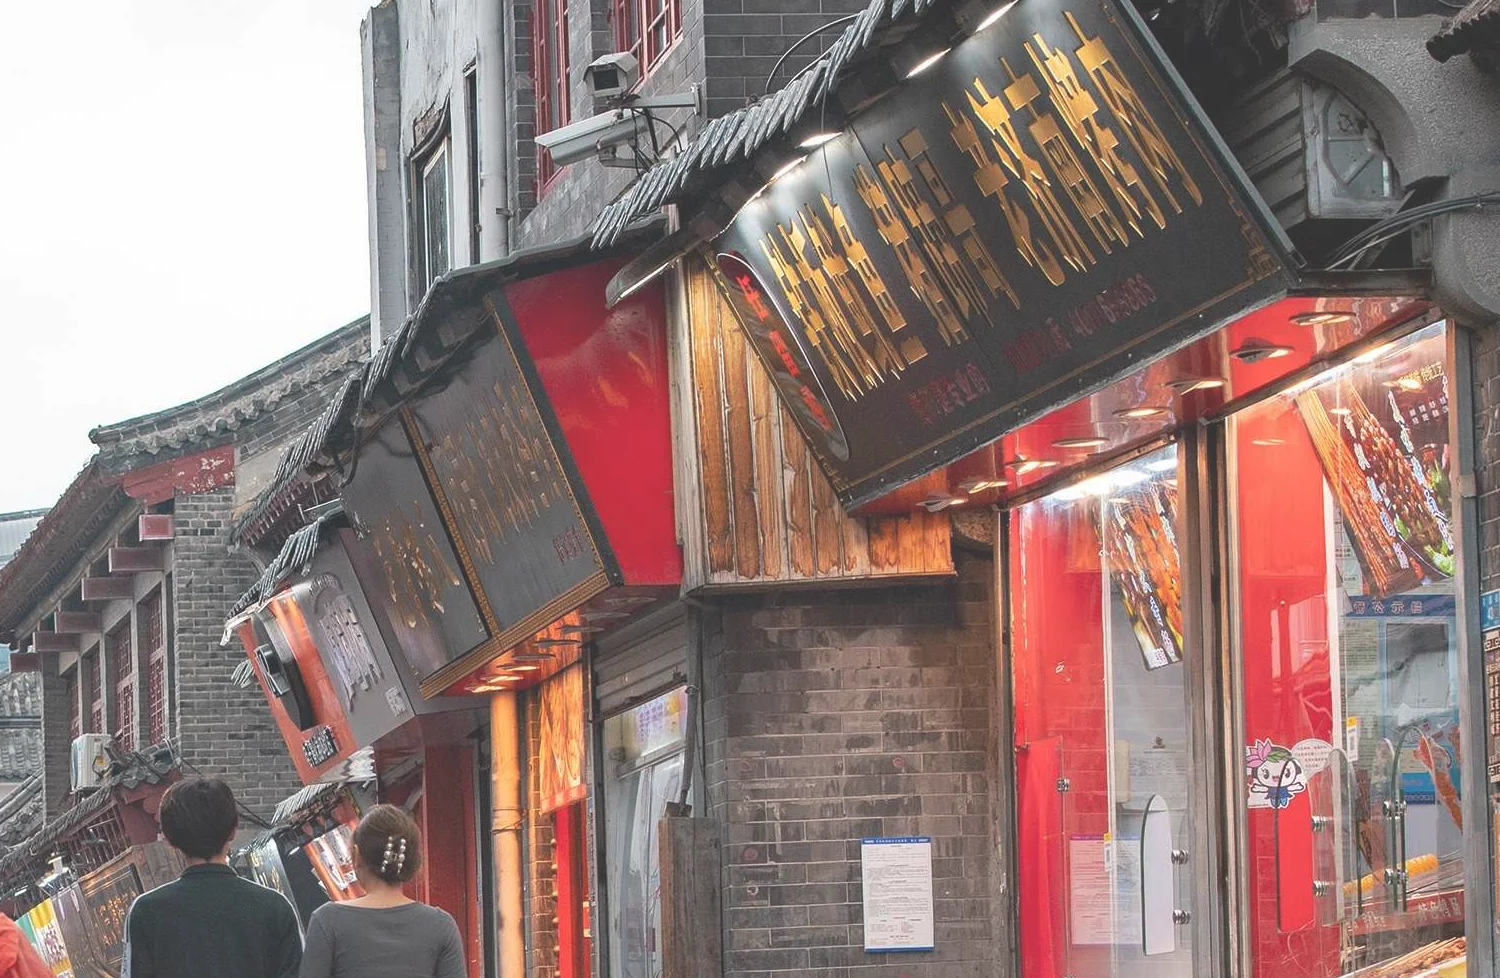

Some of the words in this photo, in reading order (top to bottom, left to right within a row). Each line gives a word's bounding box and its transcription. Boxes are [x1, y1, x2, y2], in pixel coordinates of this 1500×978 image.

[758, 192, 928, 401] 铁板鱿鱼
[853, 127, 1021, 347] 猪蹄哥
[941, 11, 1203, 287] 老济南烤肉
